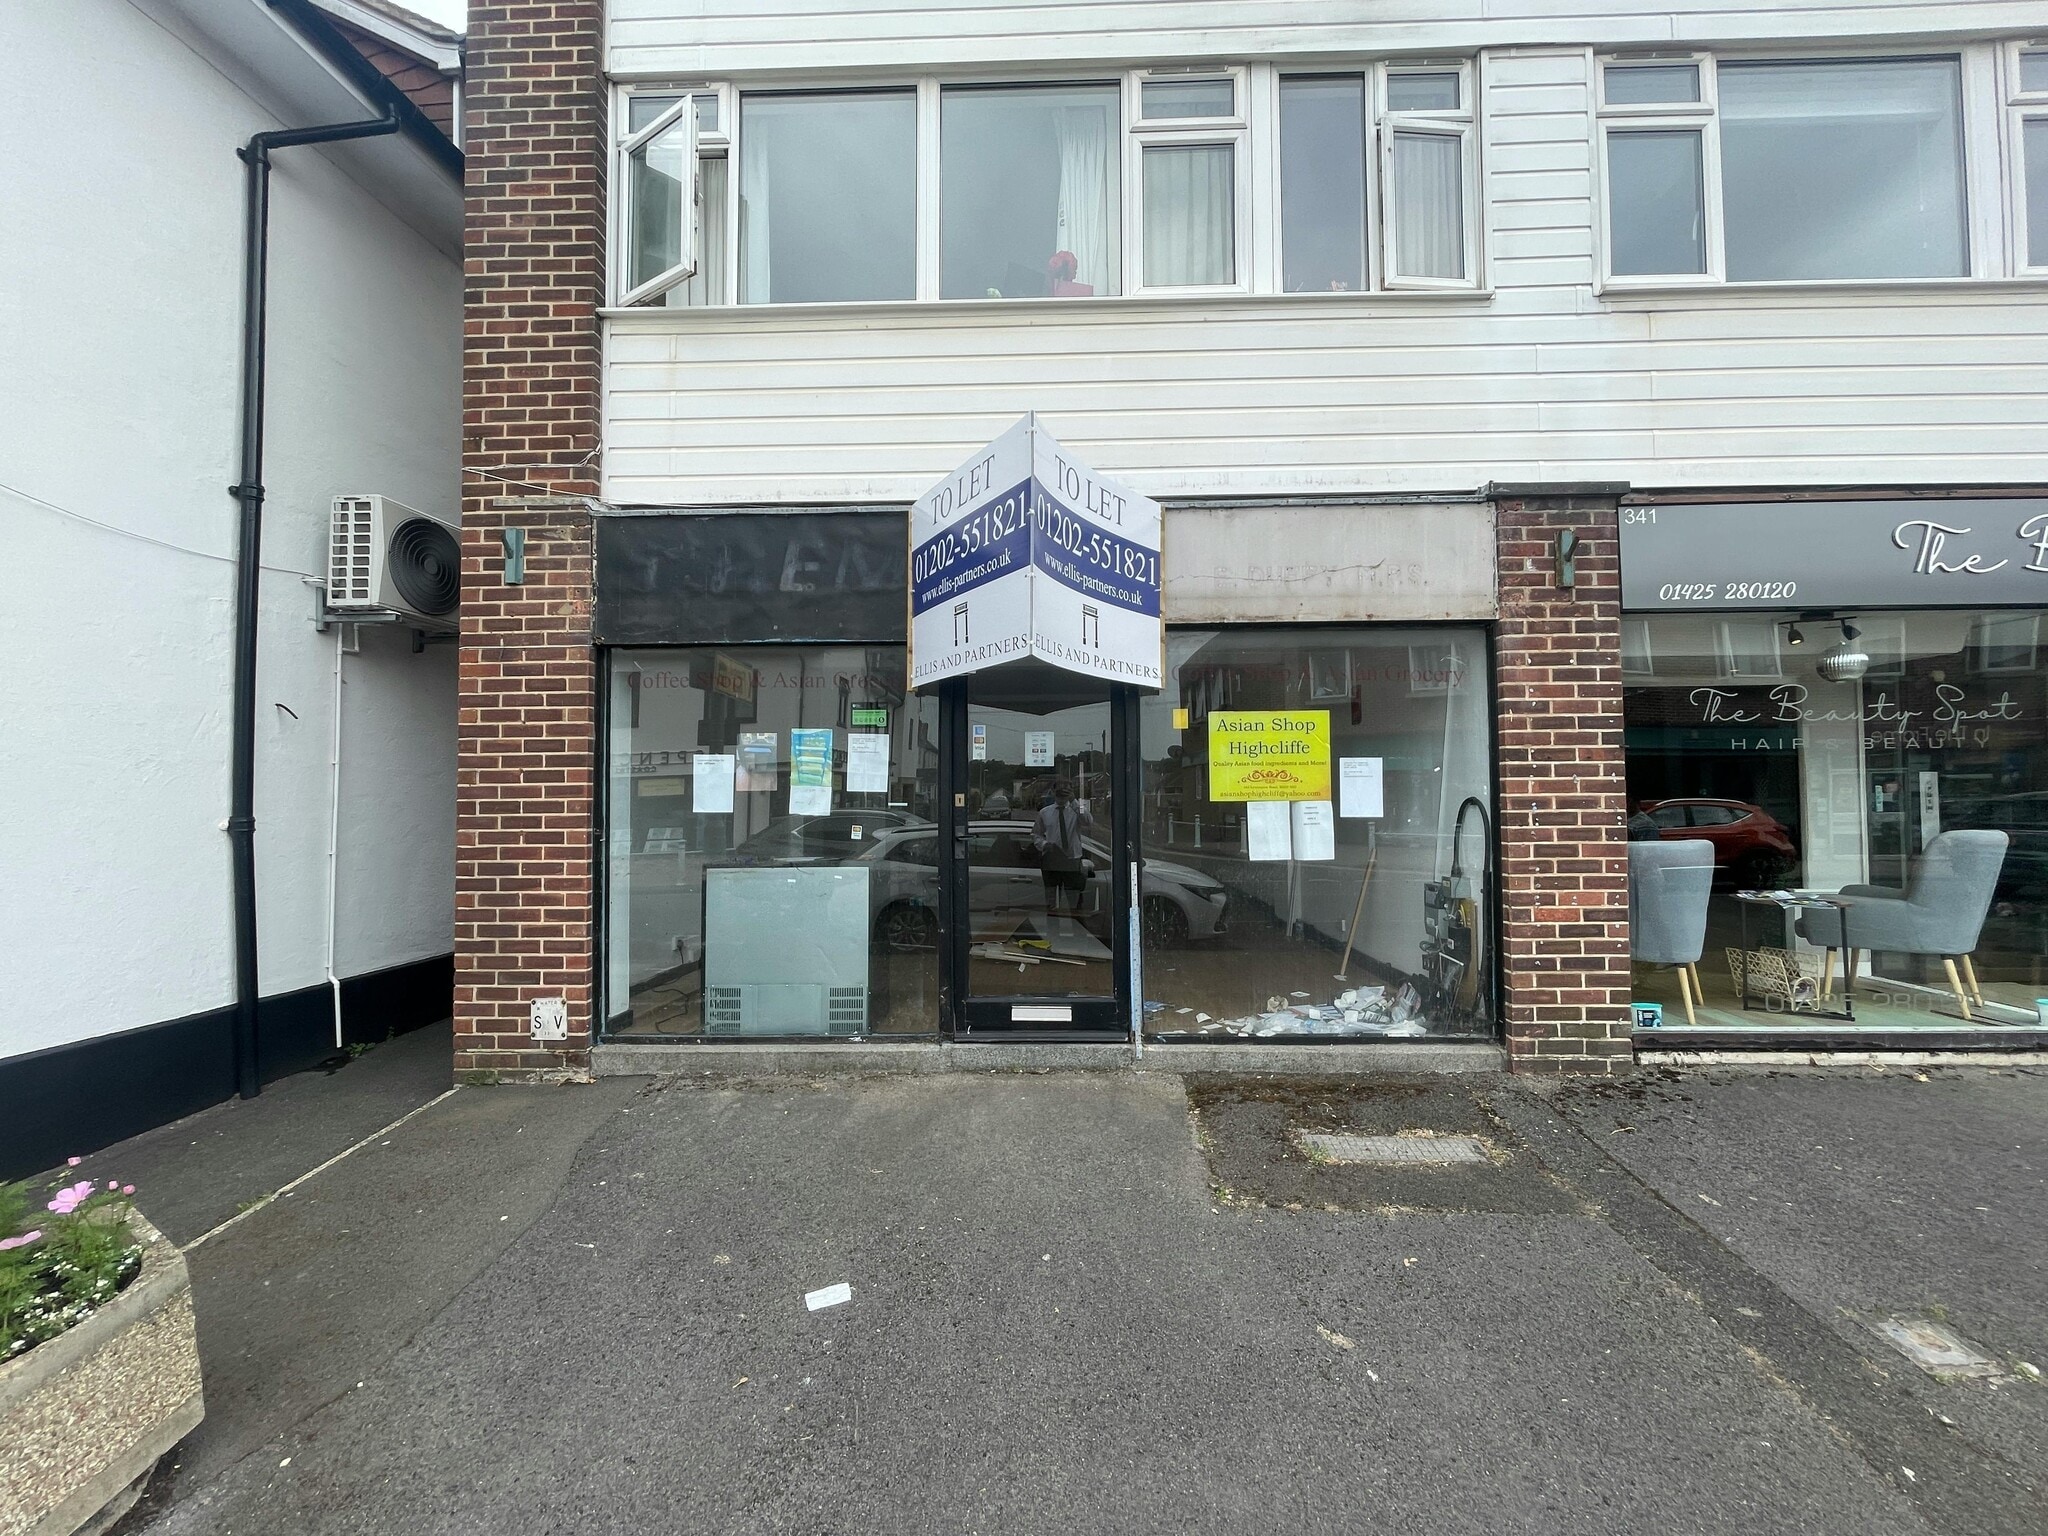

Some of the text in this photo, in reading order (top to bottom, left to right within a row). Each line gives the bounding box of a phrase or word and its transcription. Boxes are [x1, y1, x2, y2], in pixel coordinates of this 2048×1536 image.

[931, 453, 996, 525] TO LET
[1054, 453, 1127, 526] TO LET
[915, 490, 1027, 583] 01202-551821
[1037, 493, 1156, 586] 01202-551821
[1624, 508, 1657, 524] 341
[1892, 519, 2010, 575] The
[921, 547, 1012, 604] www.ellis-partners.co.uk
[1044, 550, 1143, 606] www.ellis-partners.co.uk
[1659, 581, 1796, 601] 01425 280120
[914, 633, 1029, 678] ELLIS AND PARTNERS
[1035, 632, 1159, 679] ELLIS AND PARTNERS
[627, 671, 690, 690] Coffee
[773, 671, 826, 690] Asian
[1217, 718, 1316, 734] Asian Shop
[1689, 683, 2024, 735] The Beauty Spot
[1229, 740, 1310, 758] Highcliffe
[1731, 738, 1809, 750] HAIR
[1864, 737, 1990, 750] BEAUTY
[534, 1015, 562, 1029] S V
